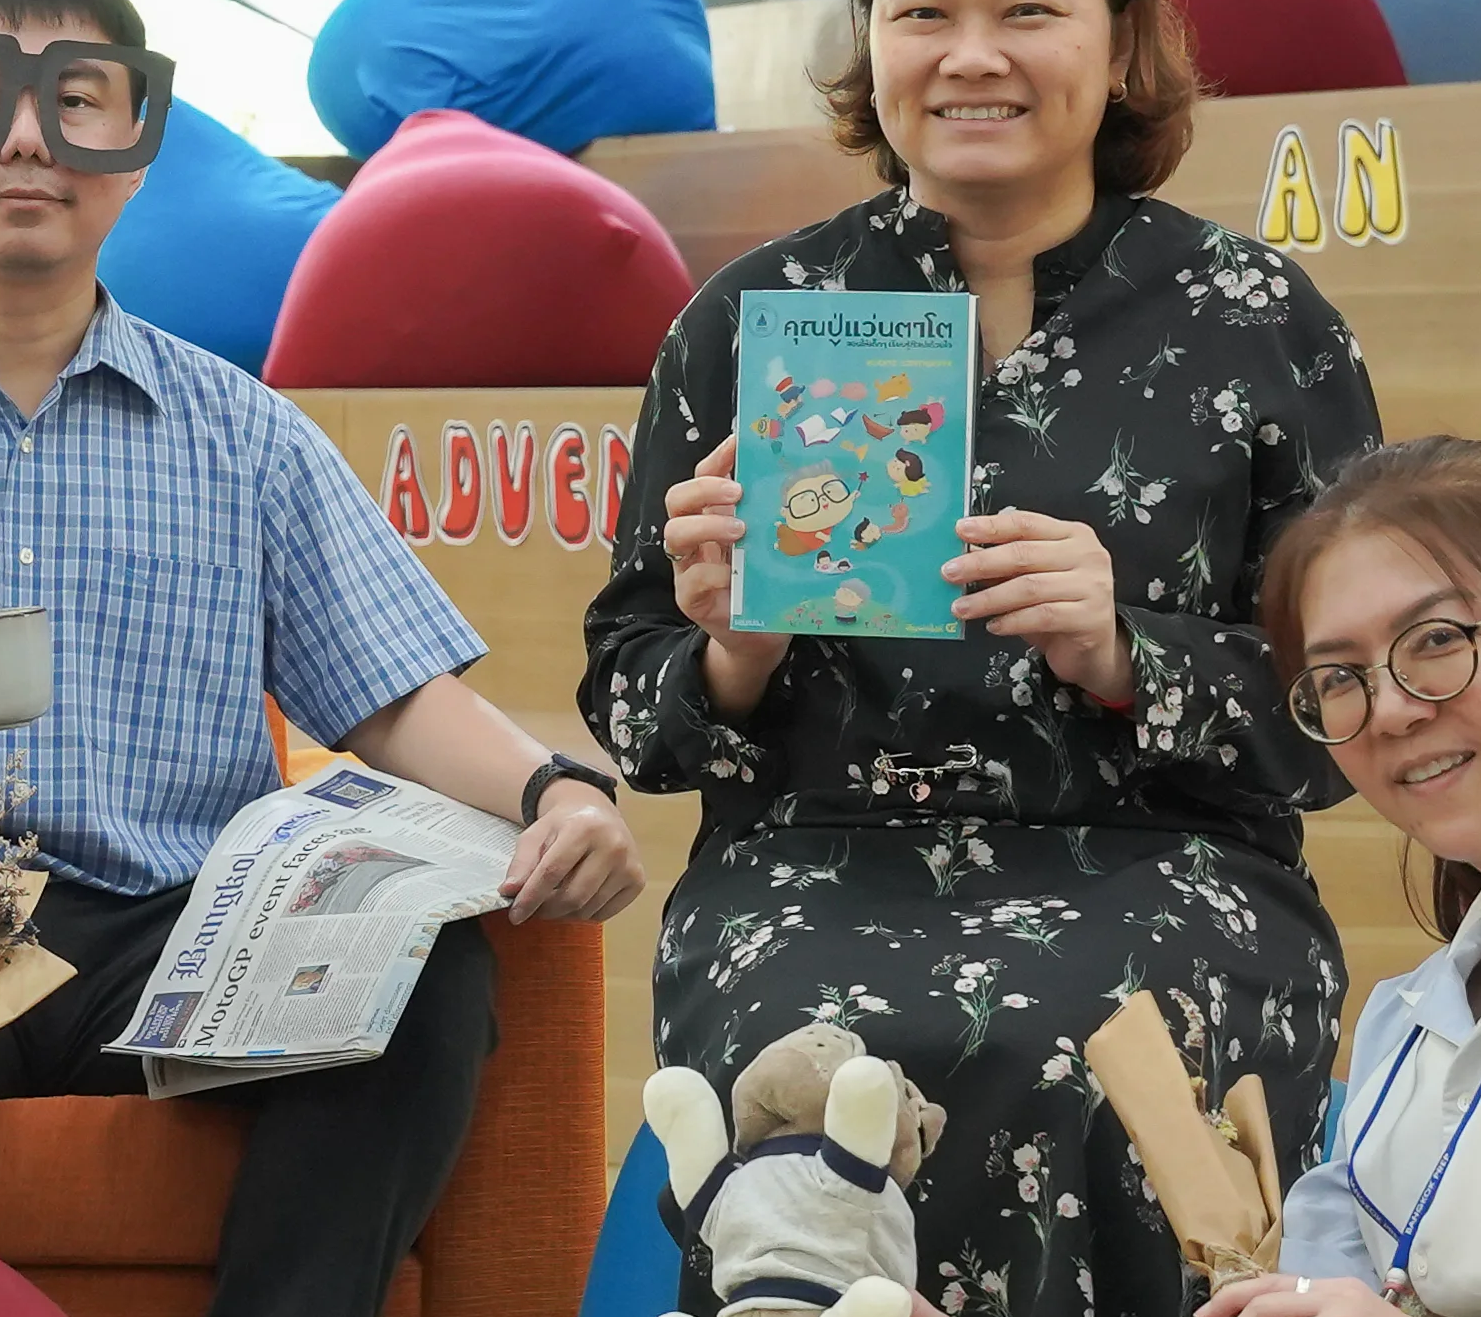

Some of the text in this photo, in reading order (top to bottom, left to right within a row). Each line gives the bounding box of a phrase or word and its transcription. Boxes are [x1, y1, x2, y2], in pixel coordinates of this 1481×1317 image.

[1256, 117, 1409, 253] AN
[783, 312, 953, 348] คุณปู่แว่นตาโต
[193, 947, 254, 1049] MotoGP
[248, 870, 294, 943] event
[290, 828, 338, 873] faces
[1404, 1180, 1435, 1236] BANGKOK
